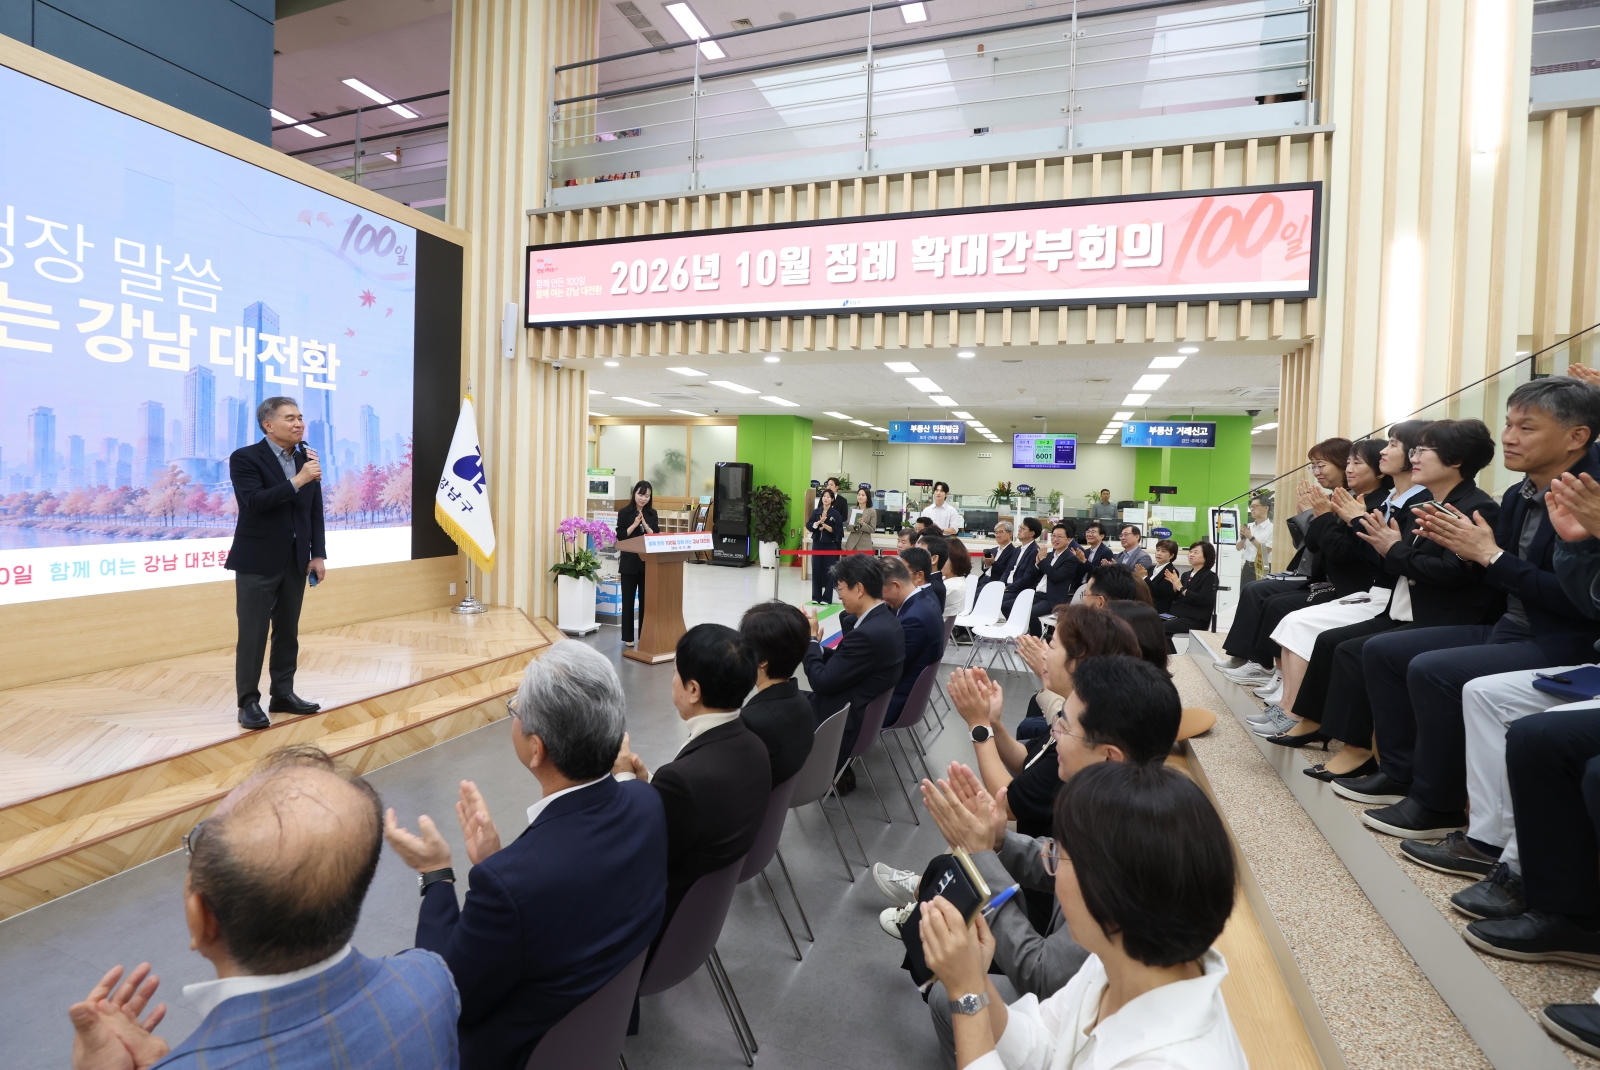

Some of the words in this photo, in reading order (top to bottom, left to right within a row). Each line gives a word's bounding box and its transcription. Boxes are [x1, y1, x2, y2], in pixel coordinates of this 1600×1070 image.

[340, 213, 409, 267] 100일
[114, 237, 223, 314] 말씀
[610, 252, 721, 296] 2026년
[736, 245, 811, 288] 10월
[825, 239, 897, 283] 정례
[911, 221, 1165, 278] 확대간부회의
[566, 276, 586, 286] 100일
[566, 287, 580, 297] 강남
[0, 281, 60, 354] 는
[76, 298, 199, 373] 강남
[209, 325, 341, 391] 대전환
[910, 424, 931, 434] 부동산
[932, 424, 960, 434] 민원발급
[1148, 426, 1174, 436] 부동산
[1176, 426, 1209, 436] 거래신고
[440, 477, 474, 513] 강남구
[50, 560, 91, 582] 함께
[100, 558, 136, 576] 여는
[144, 554, 178, 573] 강남
[185, 549, 231, 569] 대전환
